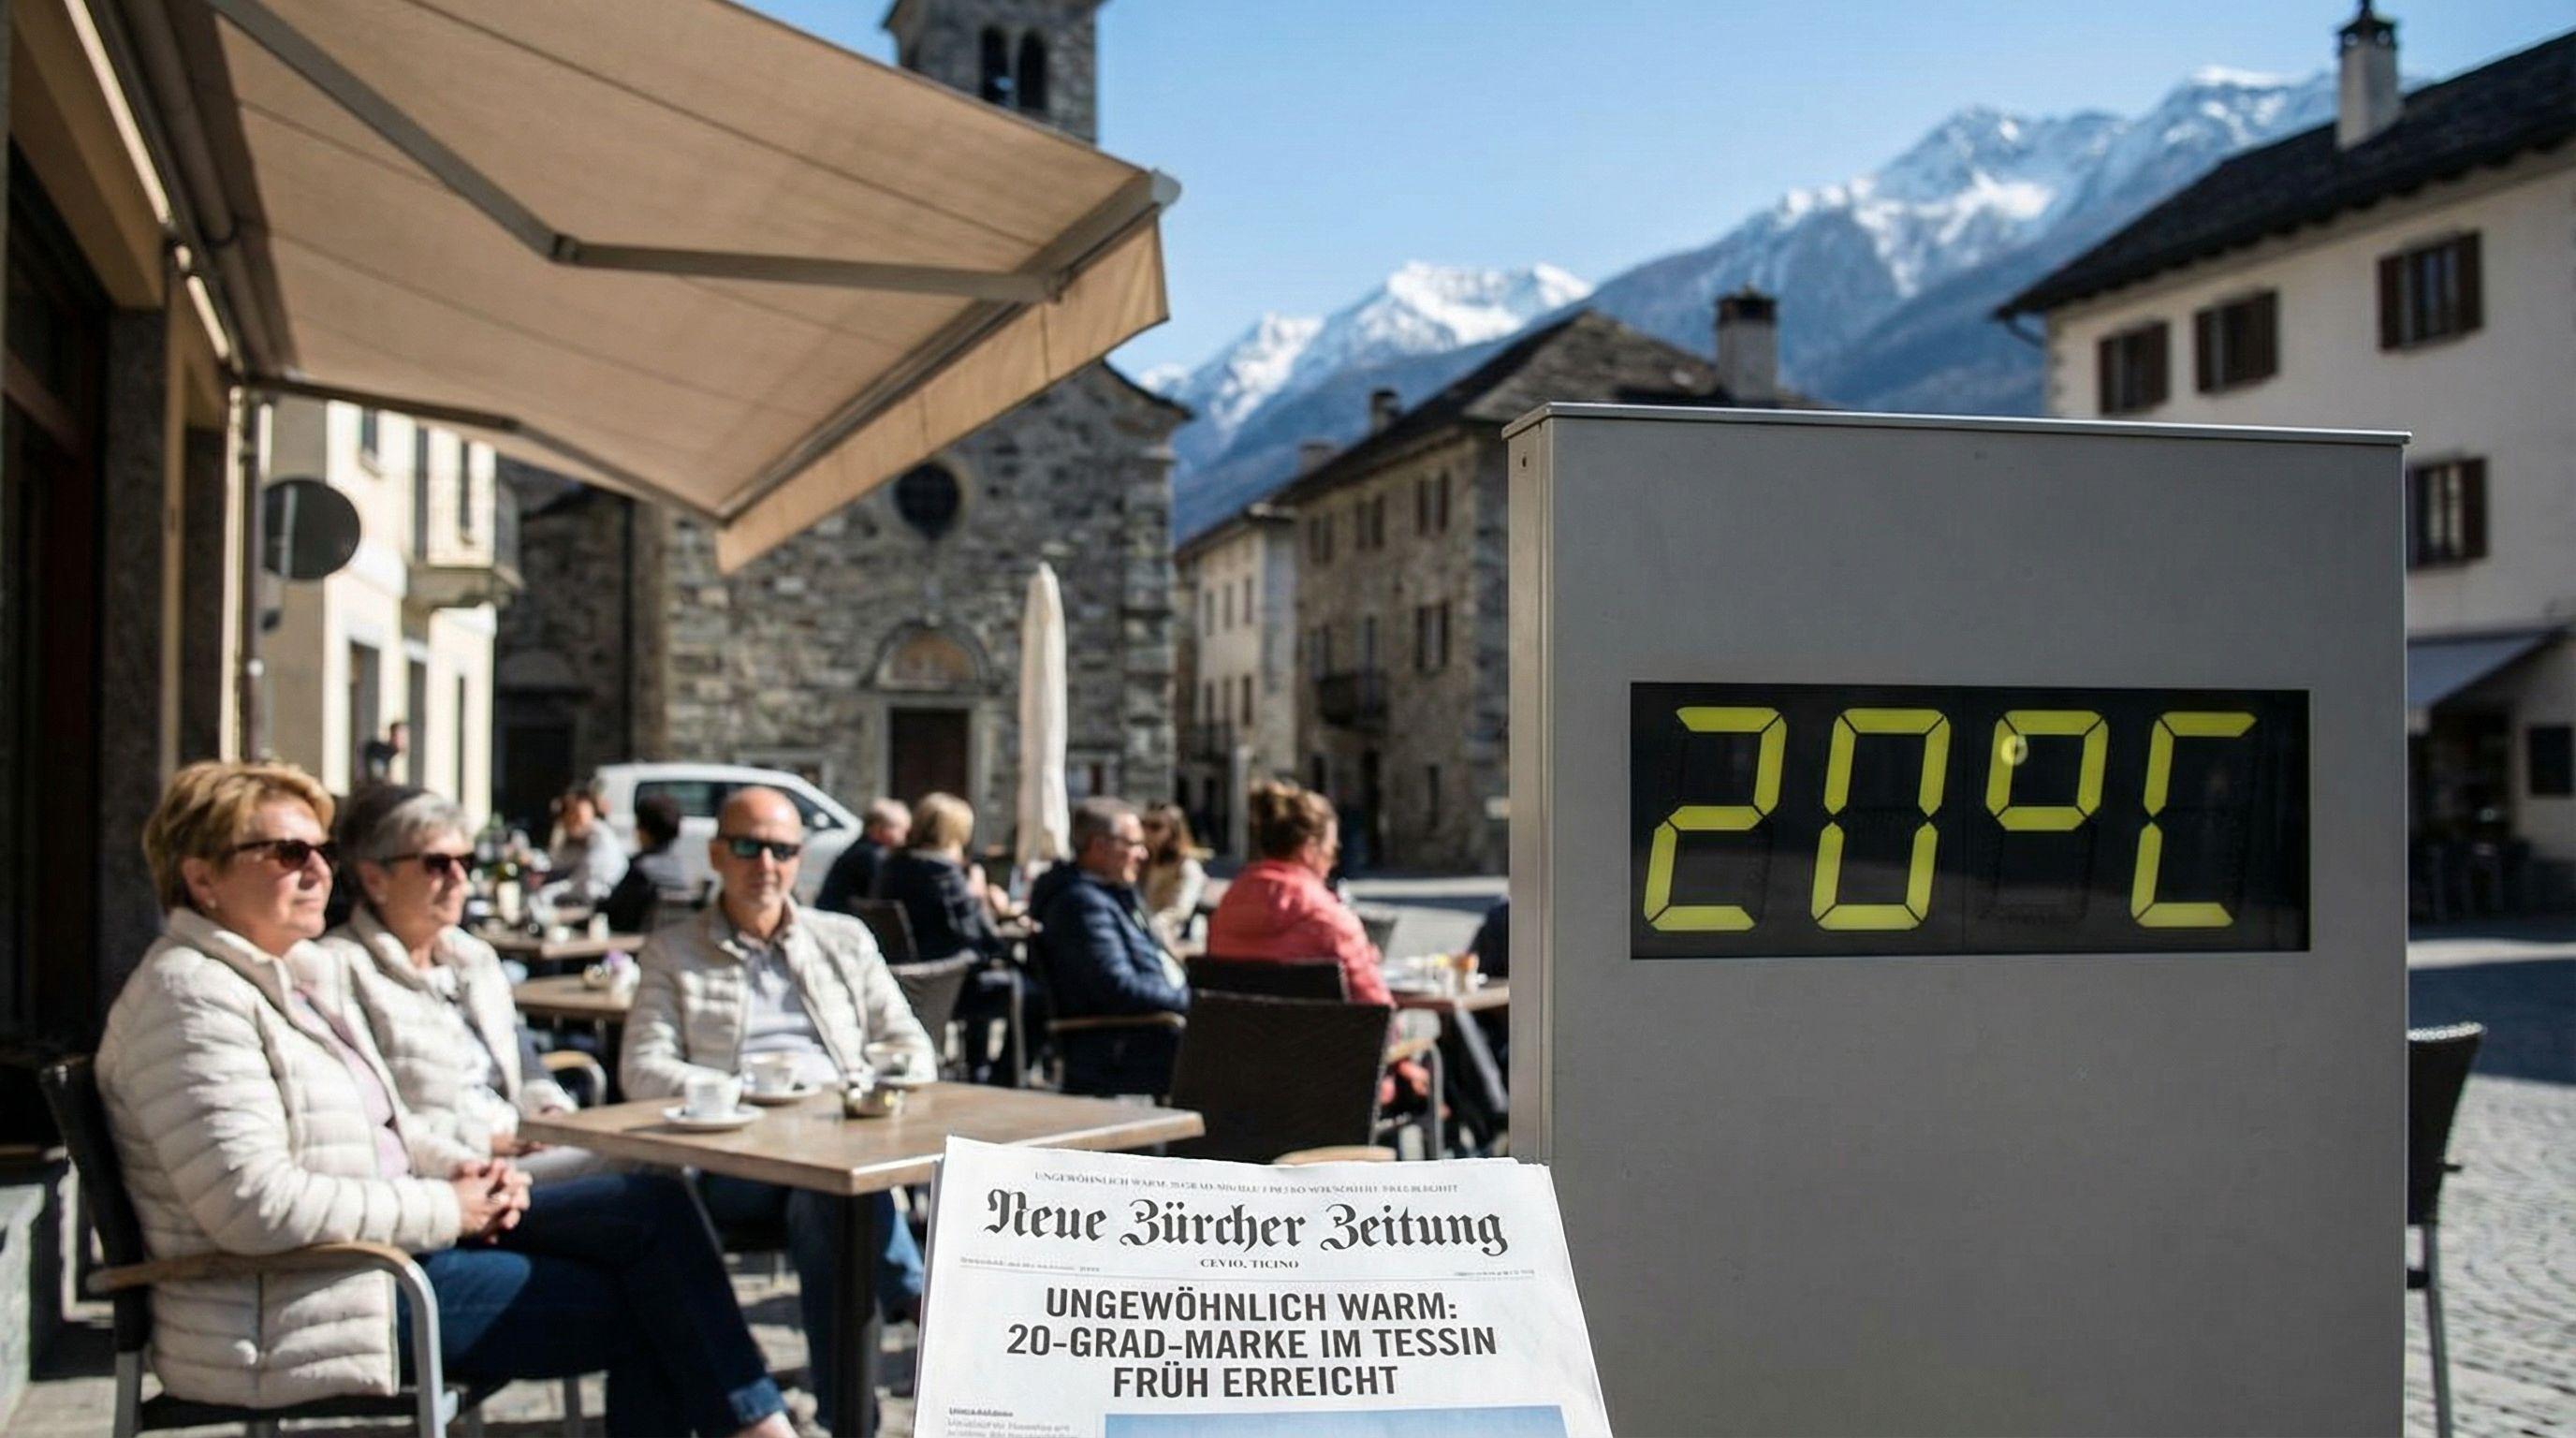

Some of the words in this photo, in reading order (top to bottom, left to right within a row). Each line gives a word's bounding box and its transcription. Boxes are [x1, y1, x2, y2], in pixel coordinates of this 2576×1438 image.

[984, 1188, 1107, 1241] Neue
[1119, 1198, 1307, 1253] Zürcher
[1320, 1203, 1509, 1256] Zeitung
[1250, 1259, 1299, 1269] TICINO
[1046, 1285, 1326, 1322] UNGEWÖHNLICH
[1337, 1292, 1457, 1321] WARM:
[1006, 1324, 1309, 1359] 20-GRAD-MARKE
[1321, 1329, 1362, 1358] IM
[1371, 1327, 1497, 1357] TESSIN
[1113, 1360, 1208, 1399] FRÜH
[1223, 1365, 1398, 1398] ERREICHT
